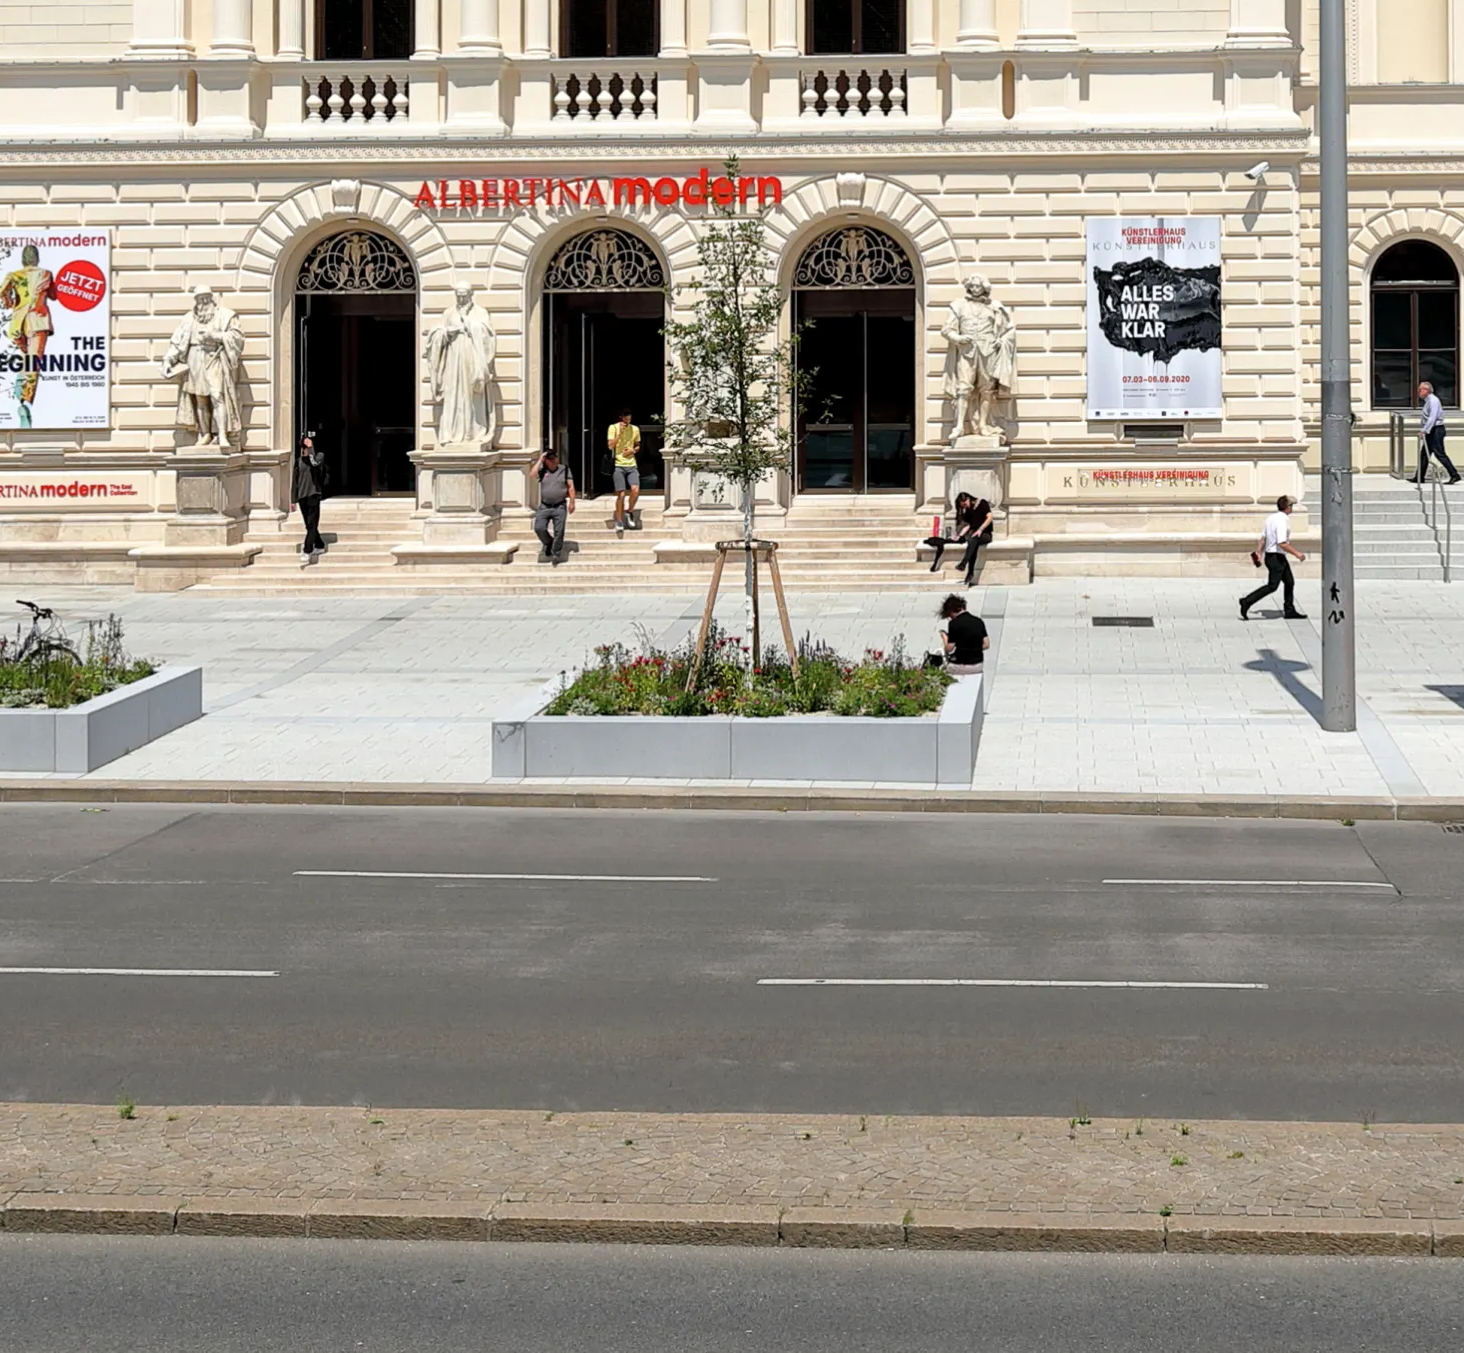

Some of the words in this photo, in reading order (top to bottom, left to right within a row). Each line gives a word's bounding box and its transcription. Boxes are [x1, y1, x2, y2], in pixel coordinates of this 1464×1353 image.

[414, 177, 607, 209] ALBERTINA
[613, 168, 782, 206] modern
[1122, 227, 1186, 236] KÜNSTLERHAUS
[48, 234, 107, 247] modern
[1126, 236, 1182, 245] VEREINIGUNG
[61, 271, 104, 292] JETZT
[57, 283, 100, 302] GEÖFFNET
[1120, 285, 1175, 302] ALLES
[1121, 304, 1160, 321] WAR
[1121, 322, 1166, 338] KLAR
[71, 336, 105, 350] THE
[1093, 470, 1154, 479] KÜNSTLERHAUS
[1156, 470, 1209, 479] VEREINIGUNG
[40, 481, 108, 498] modern
